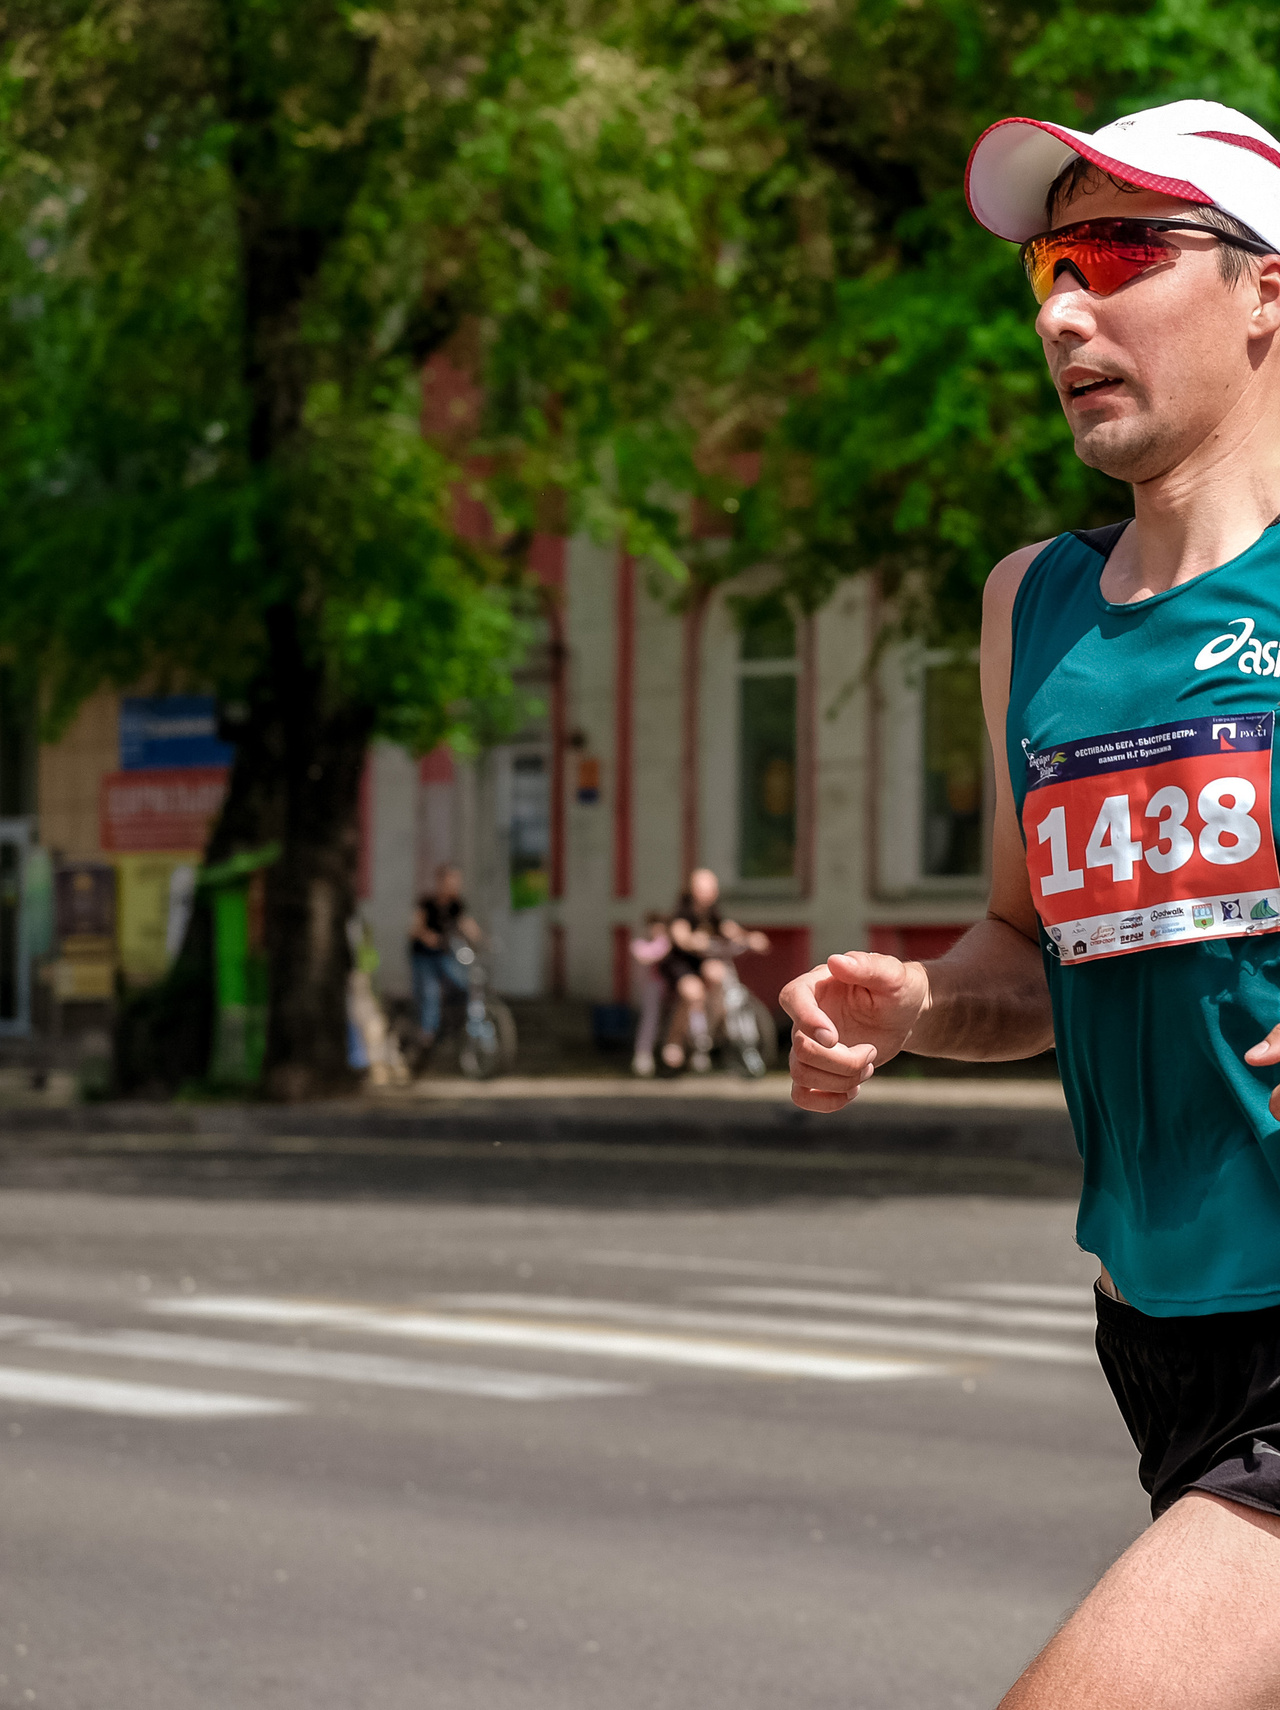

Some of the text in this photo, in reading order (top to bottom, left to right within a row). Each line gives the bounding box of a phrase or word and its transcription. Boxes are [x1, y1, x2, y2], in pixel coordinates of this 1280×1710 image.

[1074, 743, 1115, 758] ФЕСТИВАЛЬ
[1115, 739, 1135, 751] БЕГА
[1098, 754, 1126, 764] памяти
[1037, 776, 1262, 897] 1438
